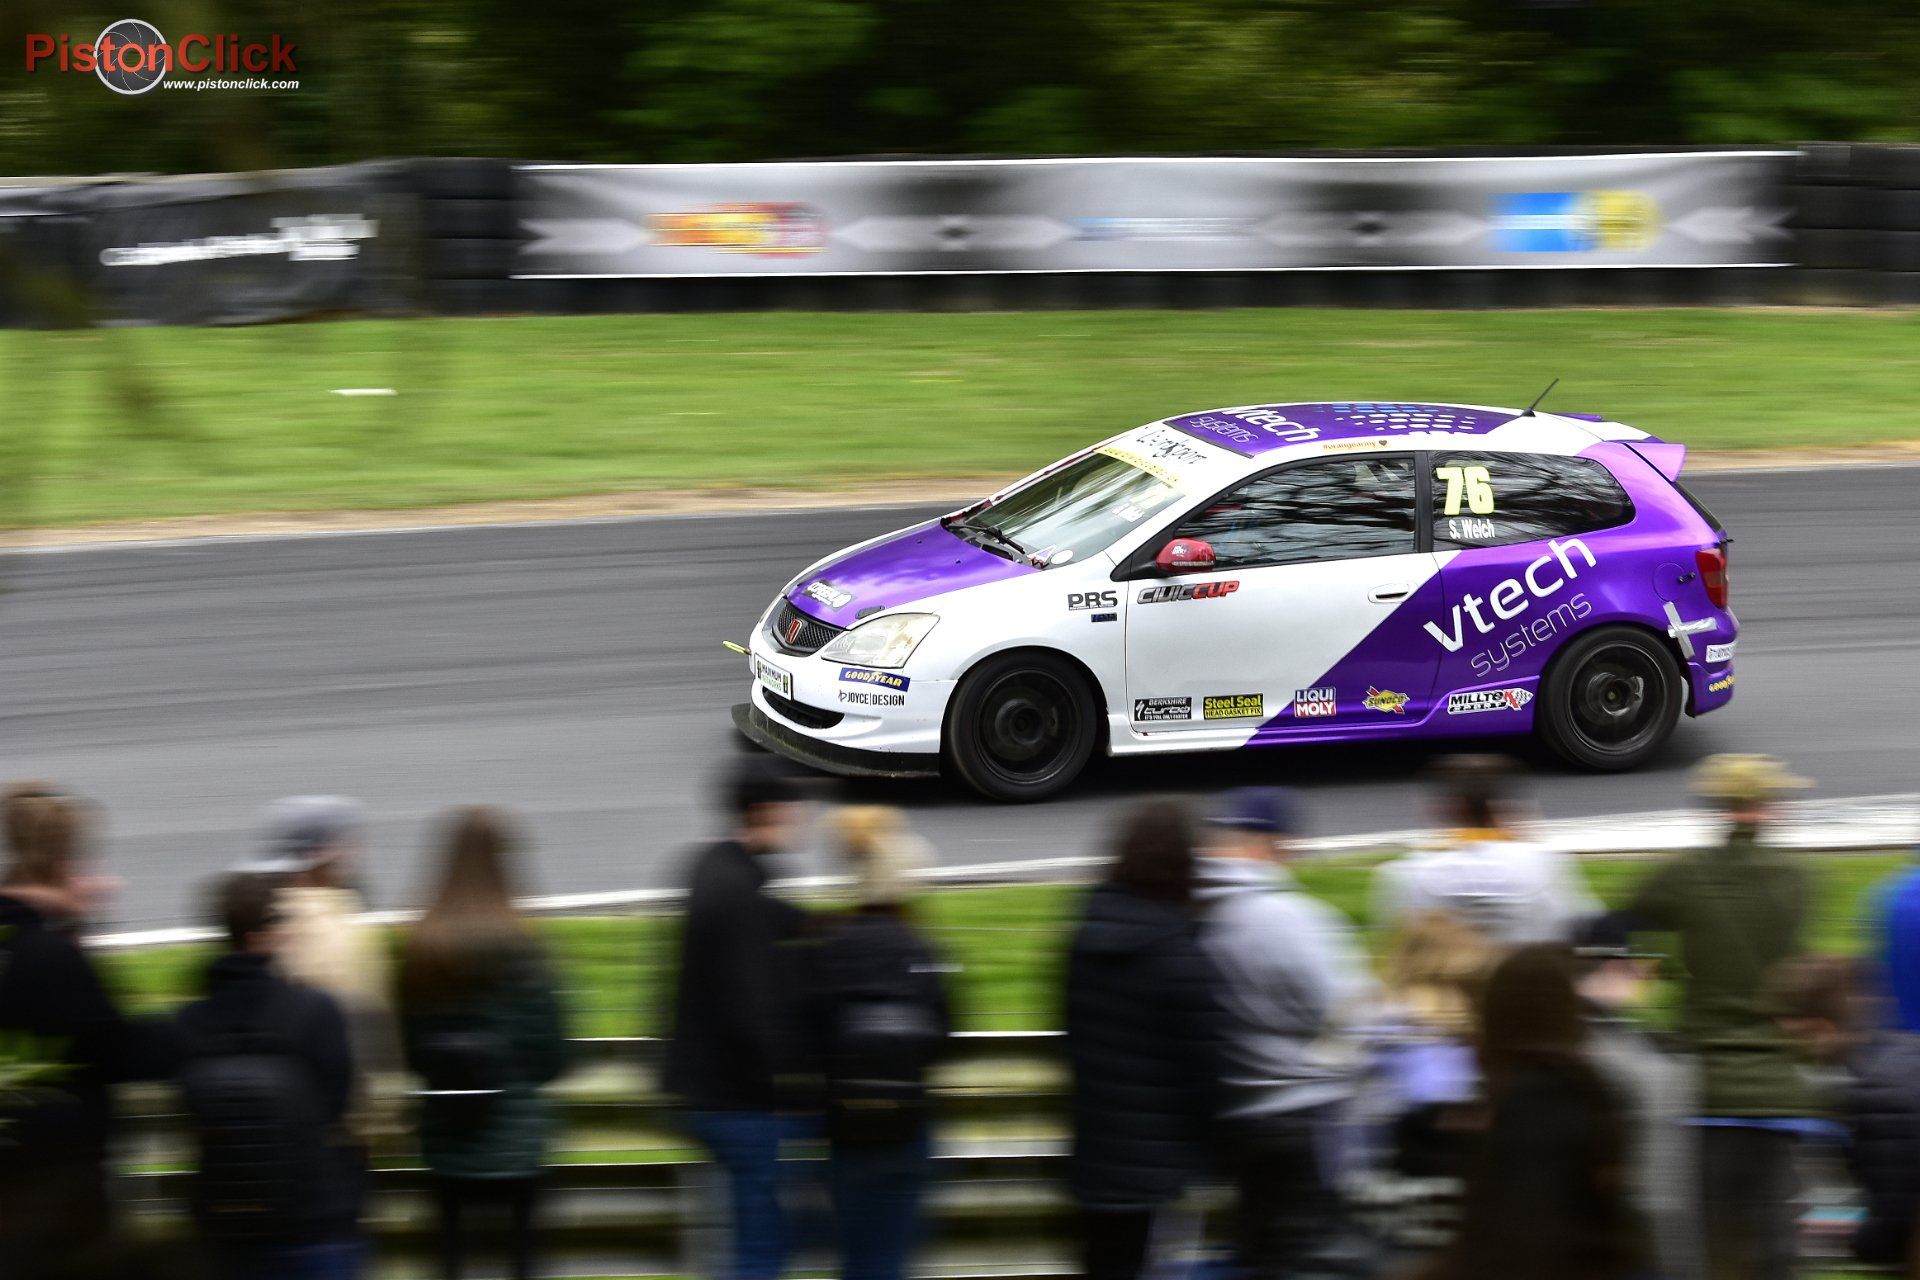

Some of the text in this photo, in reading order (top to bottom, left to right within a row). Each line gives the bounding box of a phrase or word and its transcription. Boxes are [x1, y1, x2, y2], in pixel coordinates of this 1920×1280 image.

[1435, 466, 1495, 516] 76
[1448, 518, 1496, 540] S. Welch
[1067, 590, 1119, 611] PRS
[1422, 537, 1597, 653] vtech
[1470, 592, 1593, 678] systems
[844, 670, 903, 687] GOODYEAR
[1148, 697, 1187, 706] BERKSHIRE
[1204, 694, 1262, 709] Steel Seal
[1296, 689, 1334, 702] LIQUI
[1296, 702, 1334, 716] MOLY
